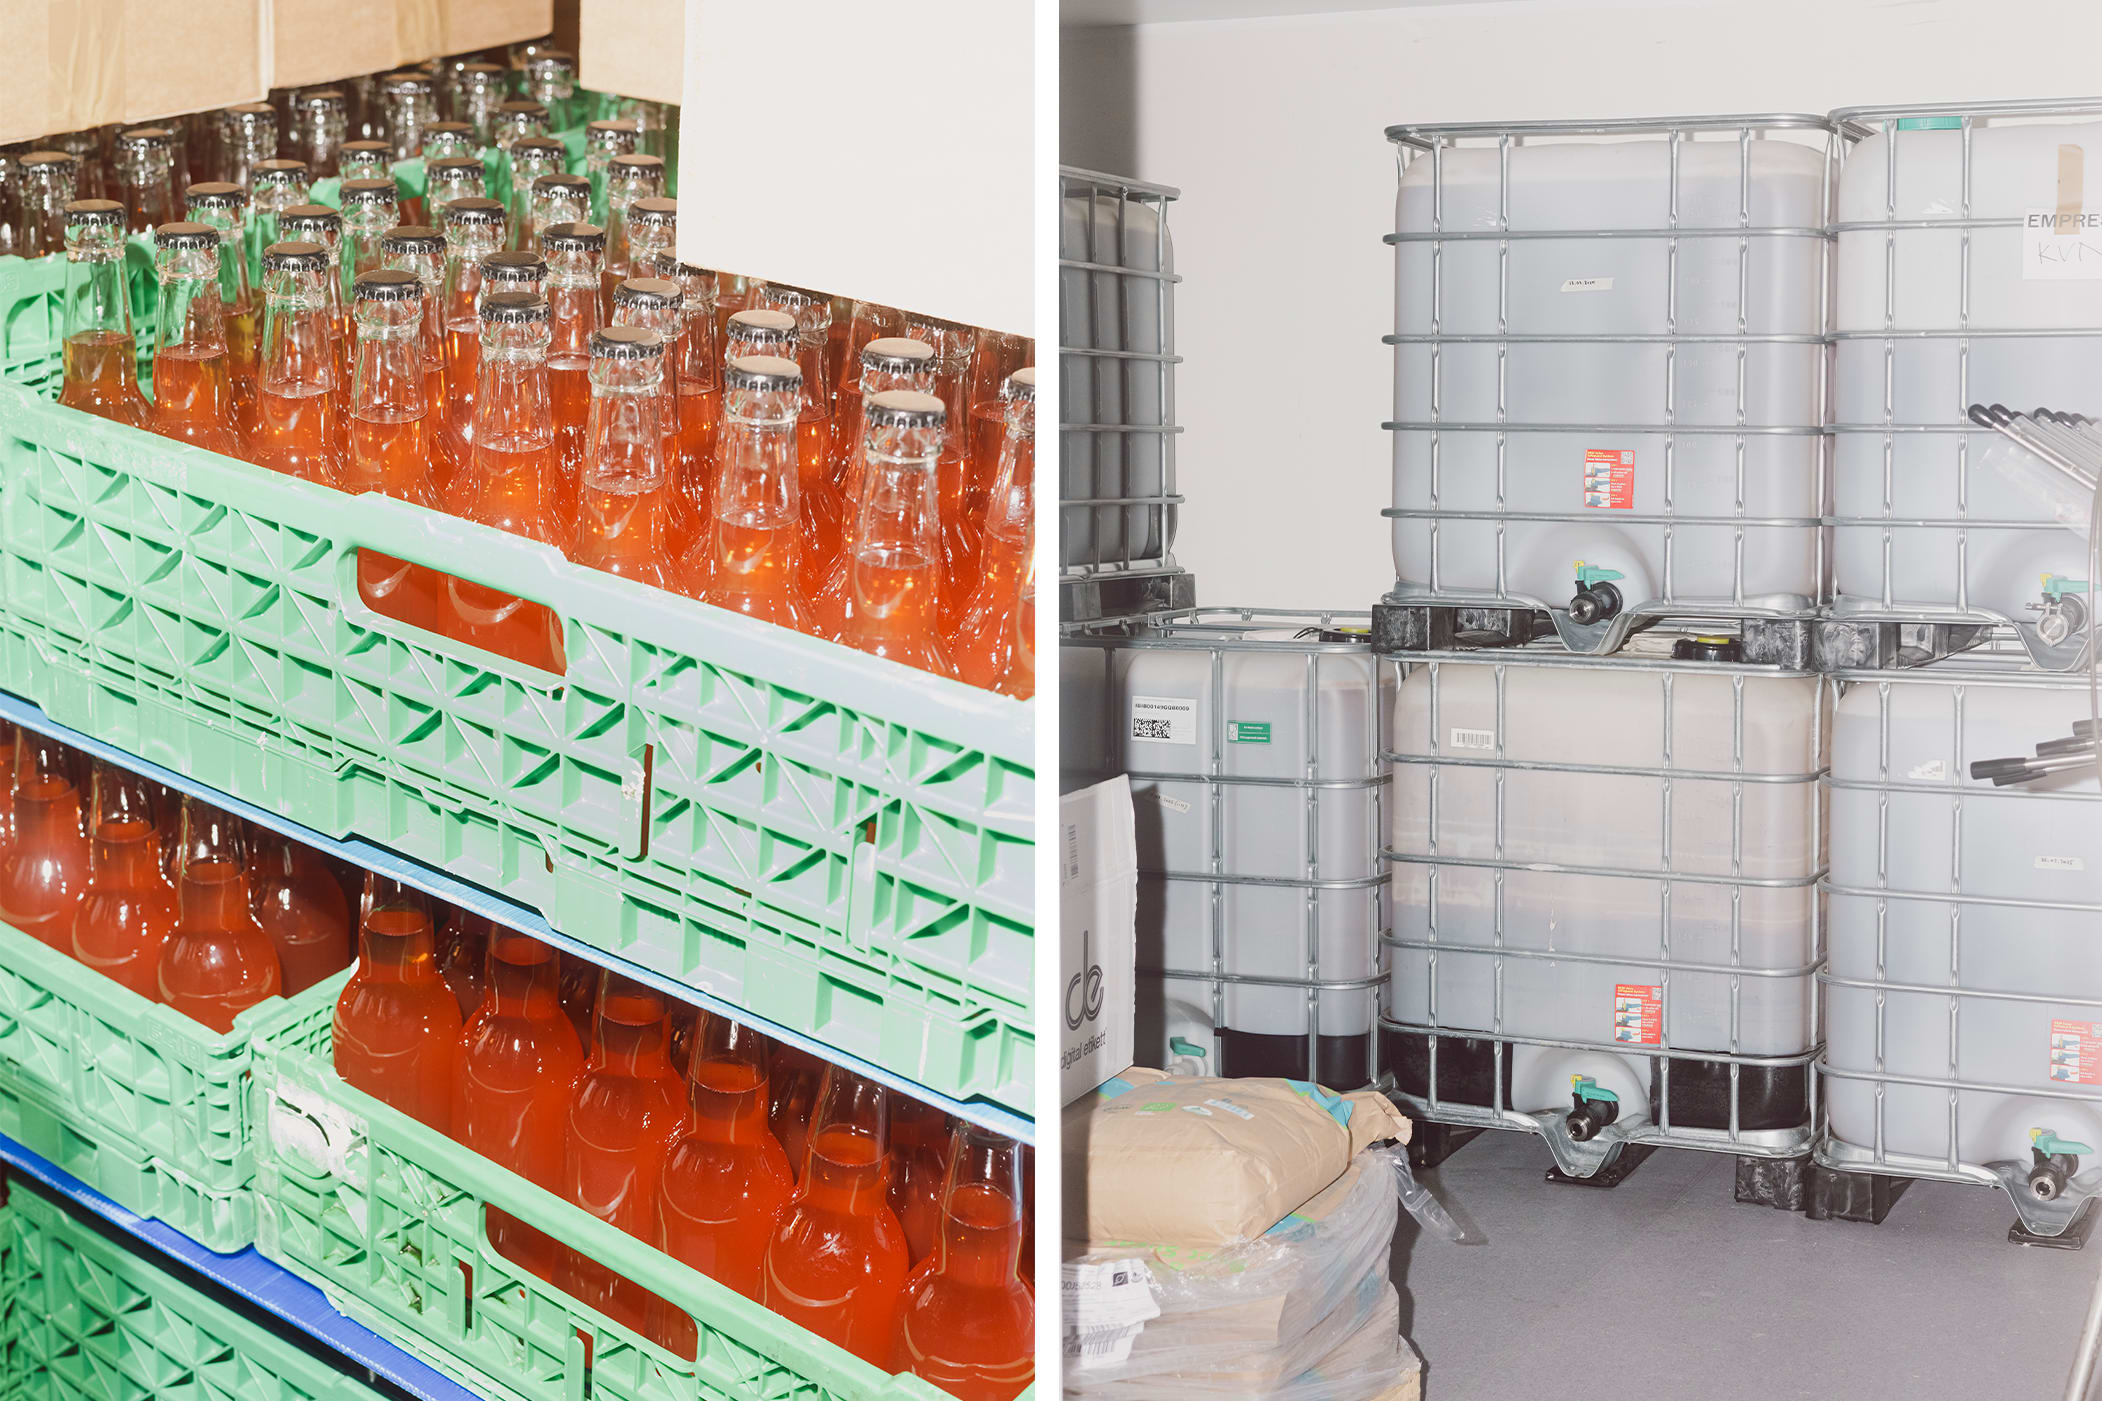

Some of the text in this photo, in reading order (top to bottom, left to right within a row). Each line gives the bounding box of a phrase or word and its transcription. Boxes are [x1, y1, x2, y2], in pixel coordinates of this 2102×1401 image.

[2027, 213, 2102, 229] EMPRE
[1061, 1030, 1106, 1070] digital etikett
